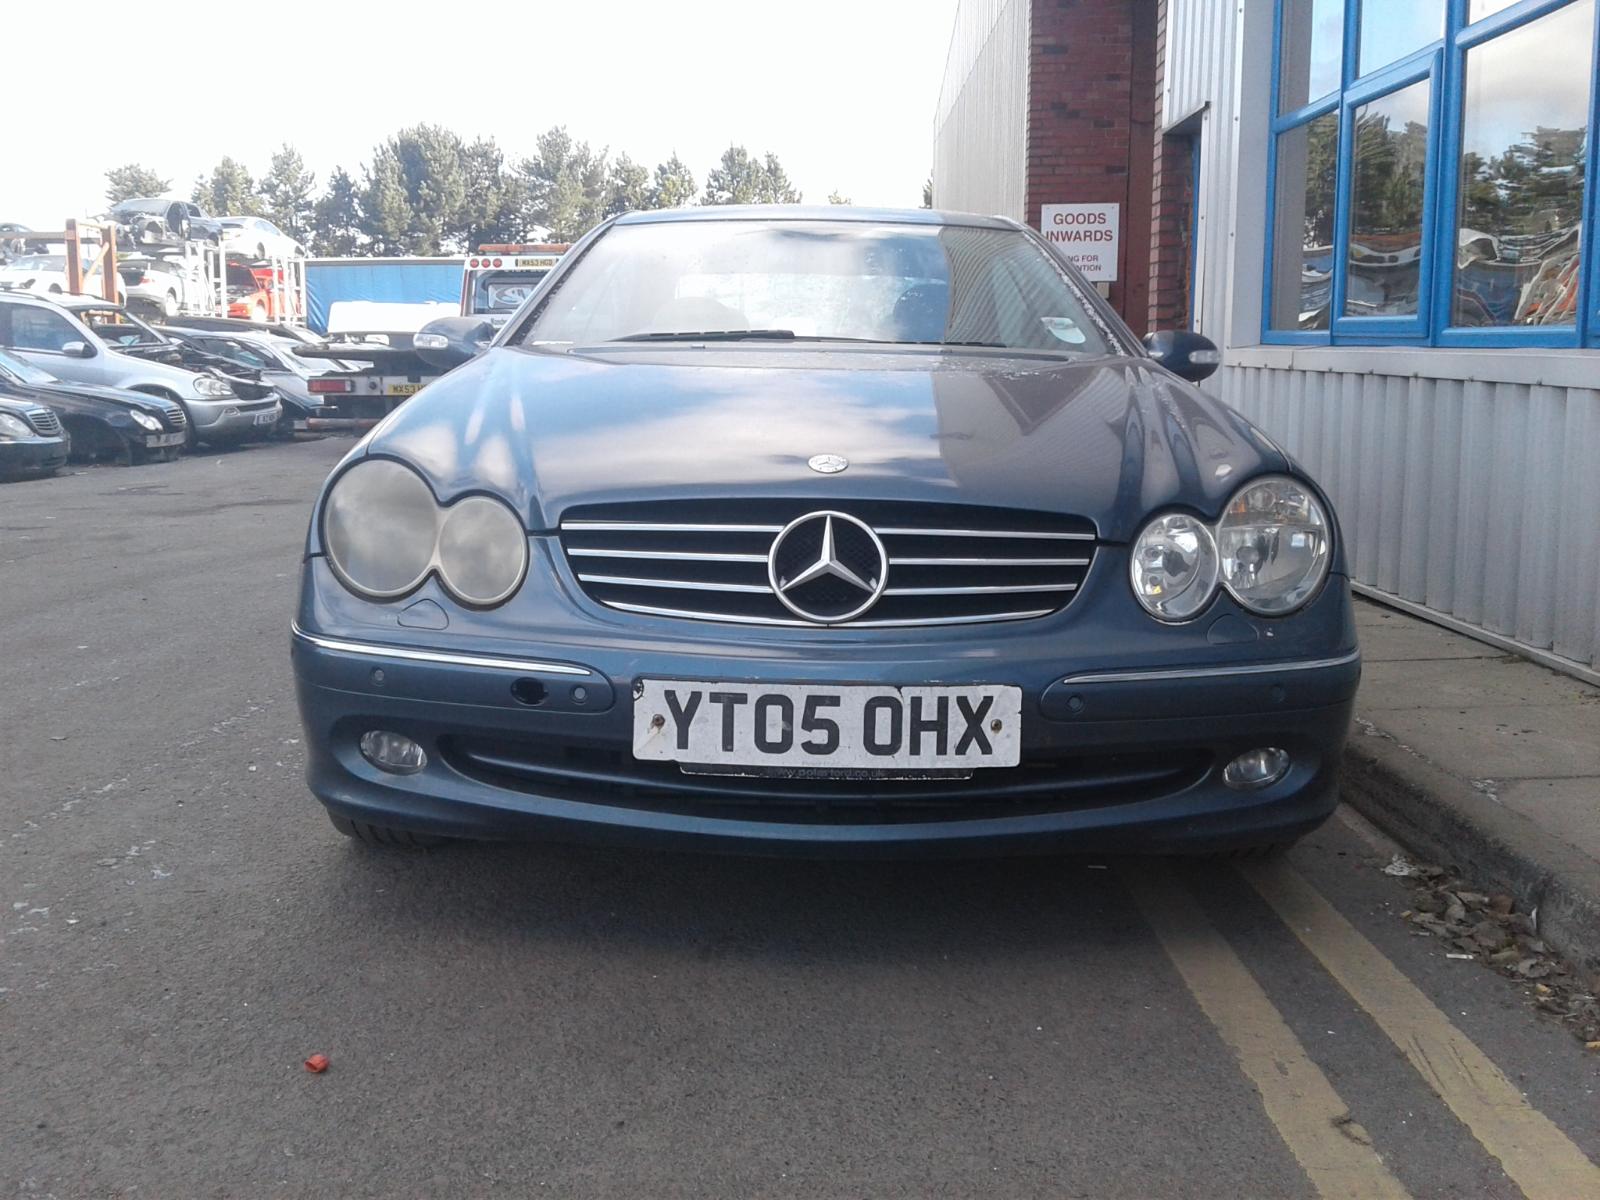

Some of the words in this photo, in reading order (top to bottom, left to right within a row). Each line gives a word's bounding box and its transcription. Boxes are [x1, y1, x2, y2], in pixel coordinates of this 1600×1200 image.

[1053, 213, 1107, 225] GOODS
[1046, 230, 1113, 242] INWARDS
[393, 384, 416, 394] MX53
[664, 689, 840, 755] YT05
[863, 695, 994, 756] OHX
